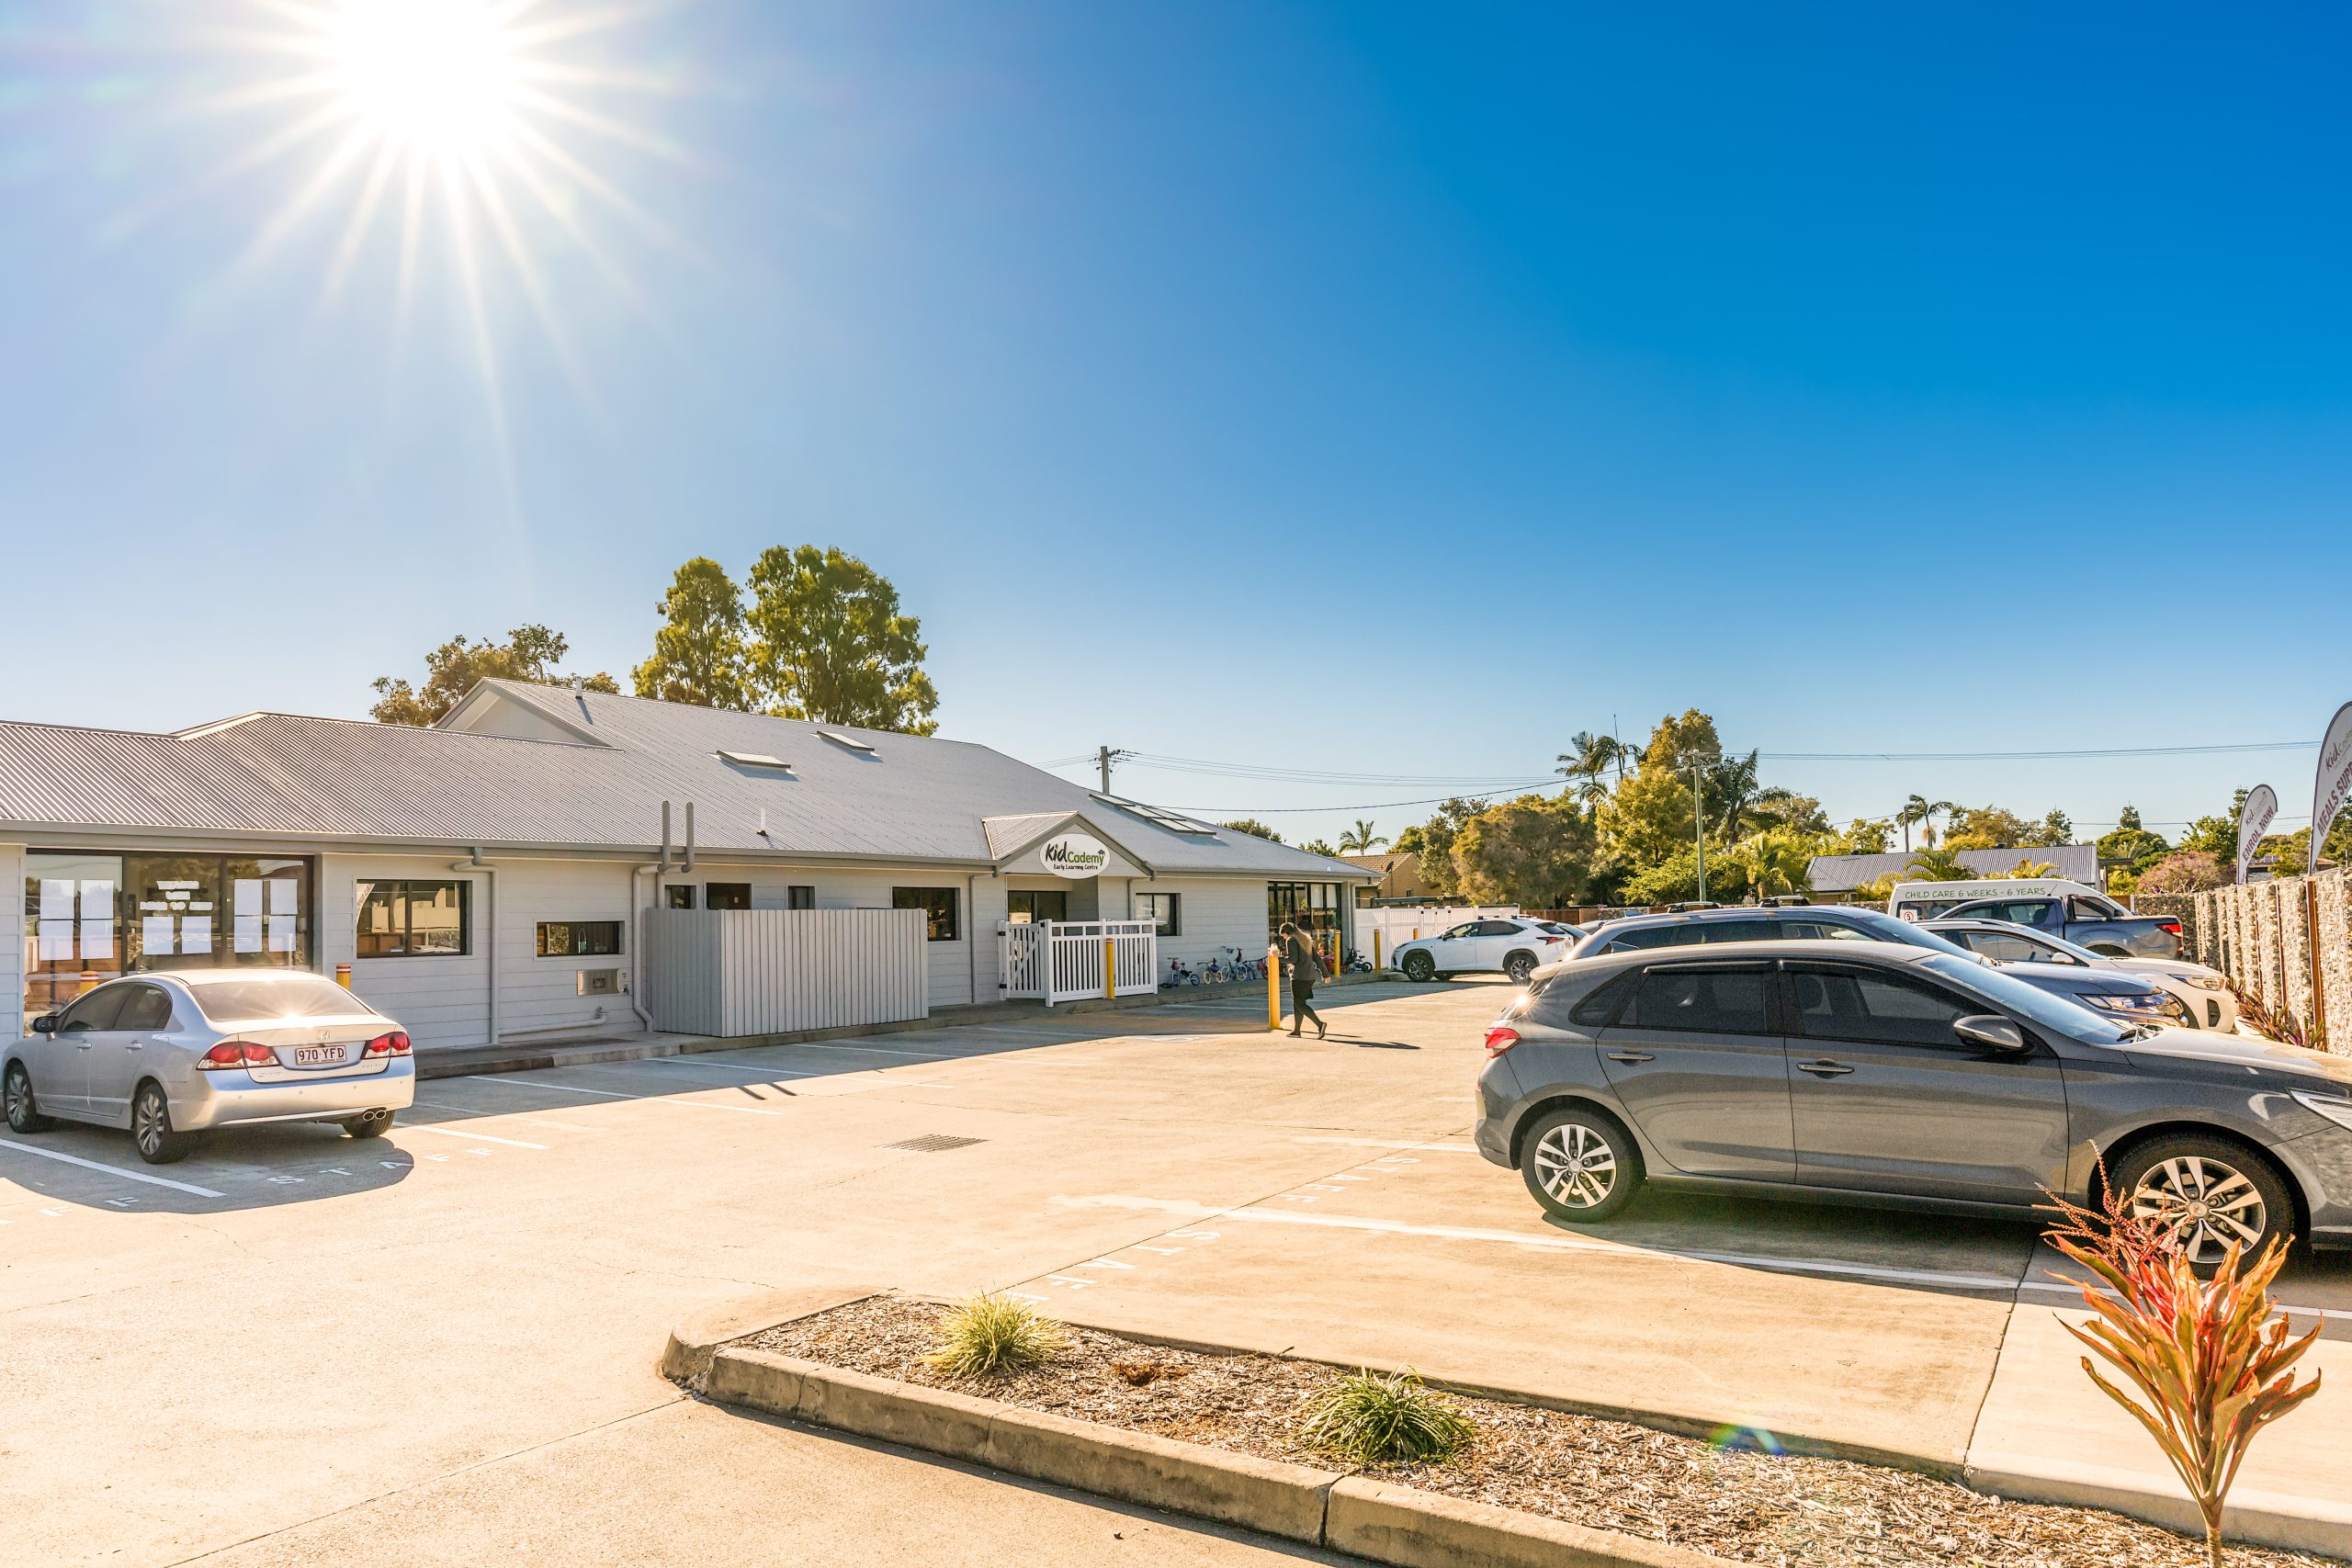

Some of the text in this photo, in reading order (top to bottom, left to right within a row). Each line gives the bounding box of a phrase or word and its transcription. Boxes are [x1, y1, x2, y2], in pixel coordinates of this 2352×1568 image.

[2243, 829, 2261, 862] ENROL
[2259, 806, 2274, 830] NOW
[2317, 789, 2338, 837] MEALS
[1905, 891, 1929, 899] CHILD
[1932, 890, 1955, 898] CARE
[1967, 888, 1997, 897] WEEKS
[2016, 887, 2046, 896] YEARS
[1277, 1156, 1422, 1203] STAFF
